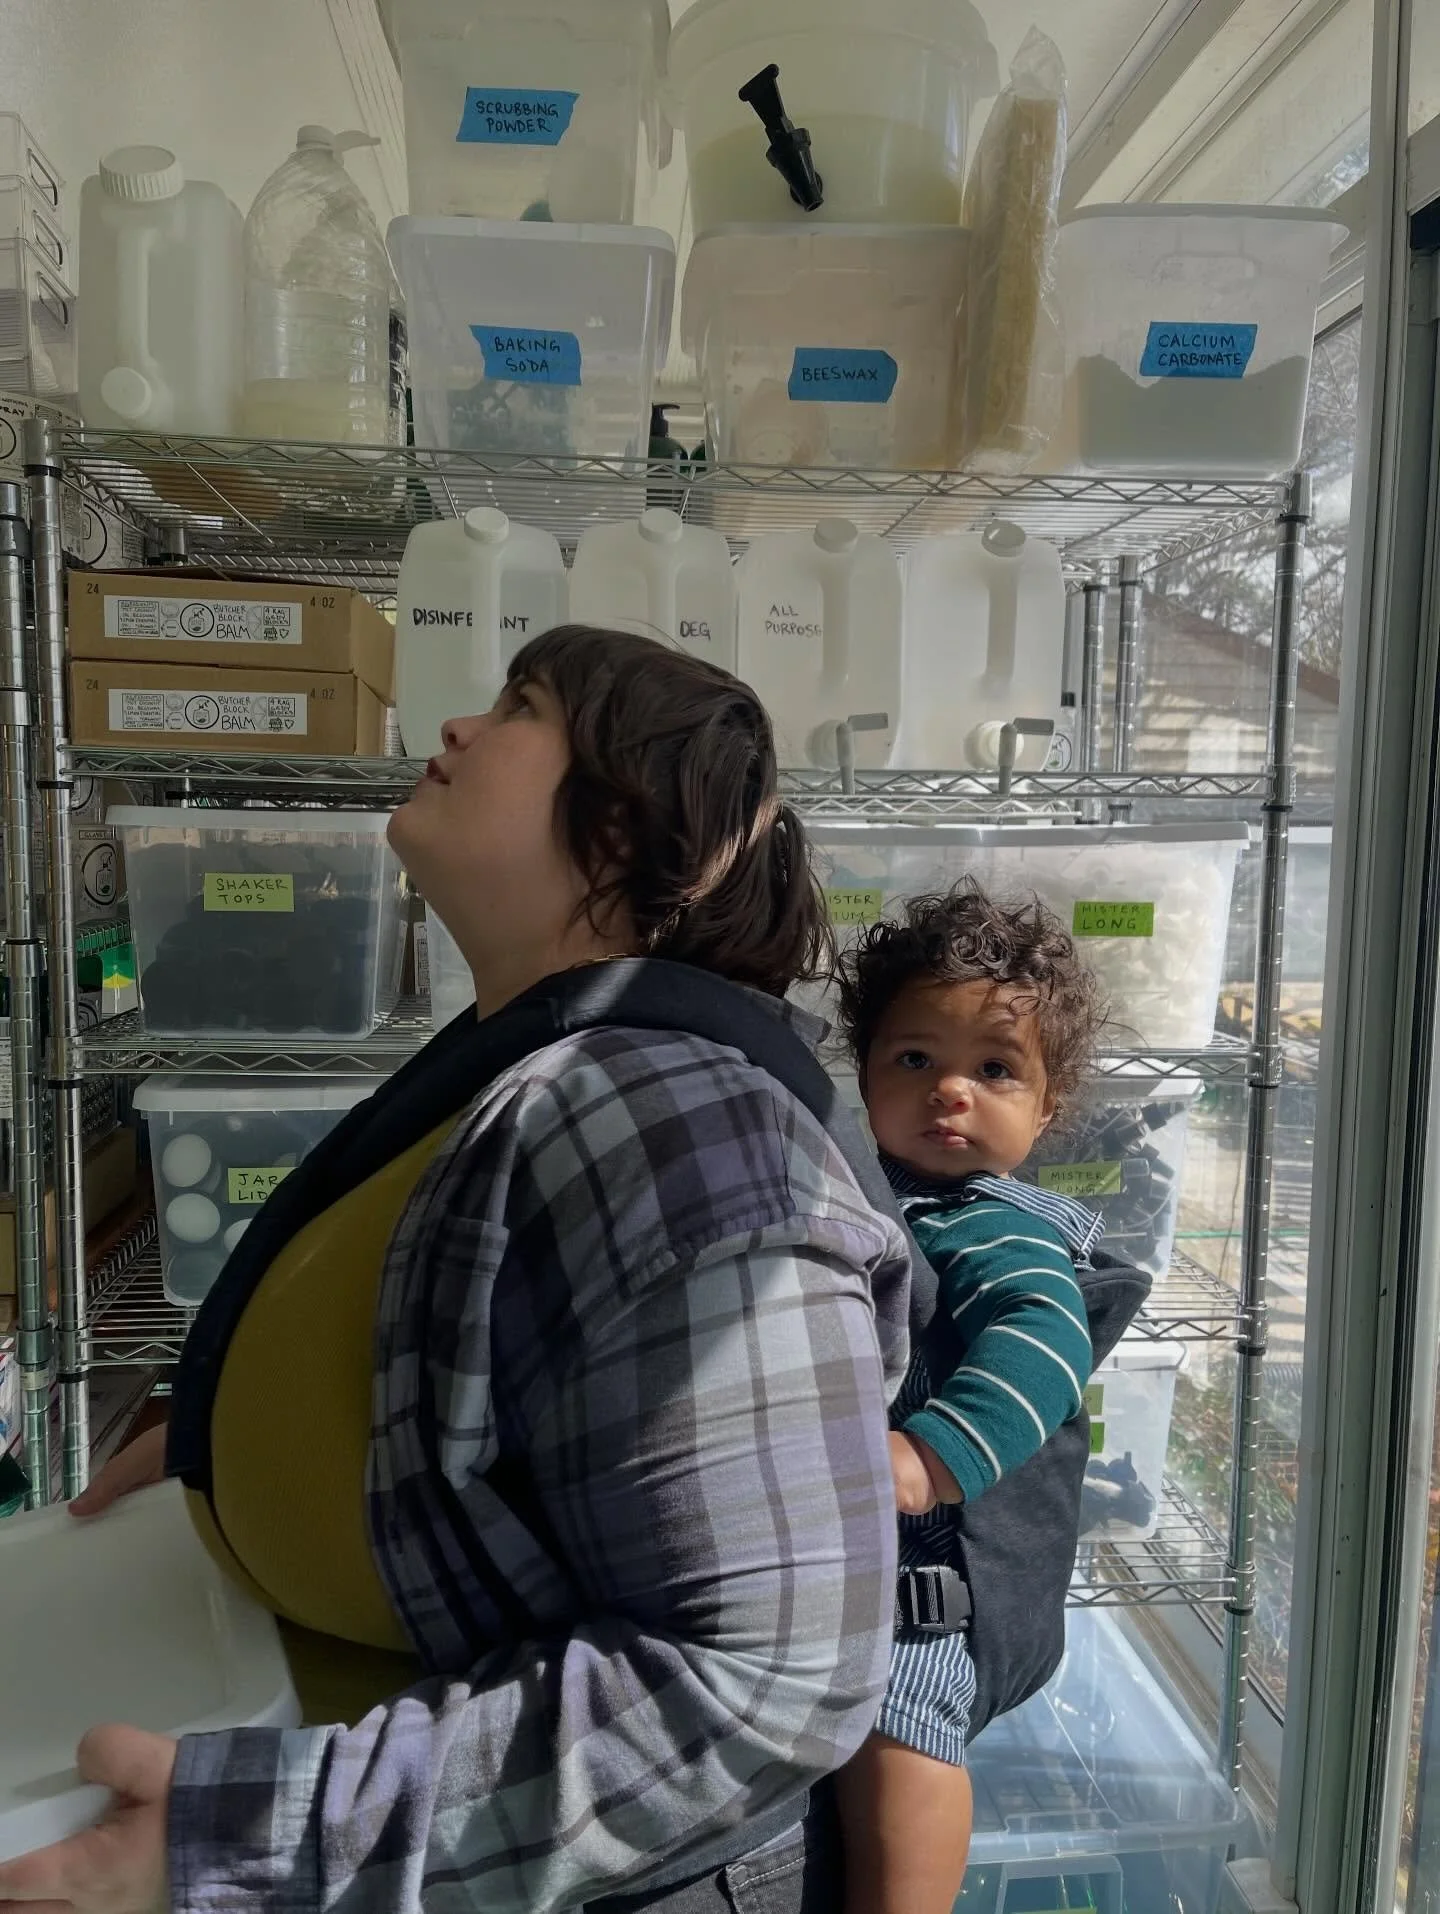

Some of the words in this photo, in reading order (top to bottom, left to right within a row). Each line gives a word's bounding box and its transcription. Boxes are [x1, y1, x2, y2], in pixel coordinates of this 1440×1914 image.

[476, 101, 559, 118] SCRUBBING
[486, 118, 552, 133] POWDER
[494, 336, 561, 353] BAKING
[1158, 333, 1236, 348] CALCIUM
[505, 358, 549, 373] SODA
[1158, 352, 1243, 367] CARBONATE
[802, 367, 878, 382] BEESWAX
[87, 582, 99, 594] 24
[213, 604, 246, 614] BUTCHER
[310, 596, 315, 608] 4
[322, 596, 335, 609] OZ
[769, 604, 799, 617] ALL
[218, 614, 244, 623] BLOCK
[216, 624, 251, 640] BALM
[86, 679, 99, 690] 24
[218, 696, 250, 705] BUTCHER
[310, 688, 315, 699] 4
[322, 688, 336, 700] OZ
[223, 705, 249, 714] BLOCK
[221, 715, 256, 731] BALM
[216, 877, 289, 891] SHAKER
[218, 893, 265, 904] TOPS
[1082, 904, 1139, 913] MISTER
[1082, 919, 1136, 930] LONG
[238, 1173, 278, 1186] JAR
[1050, 1171, 1103, 1181] MISTER
